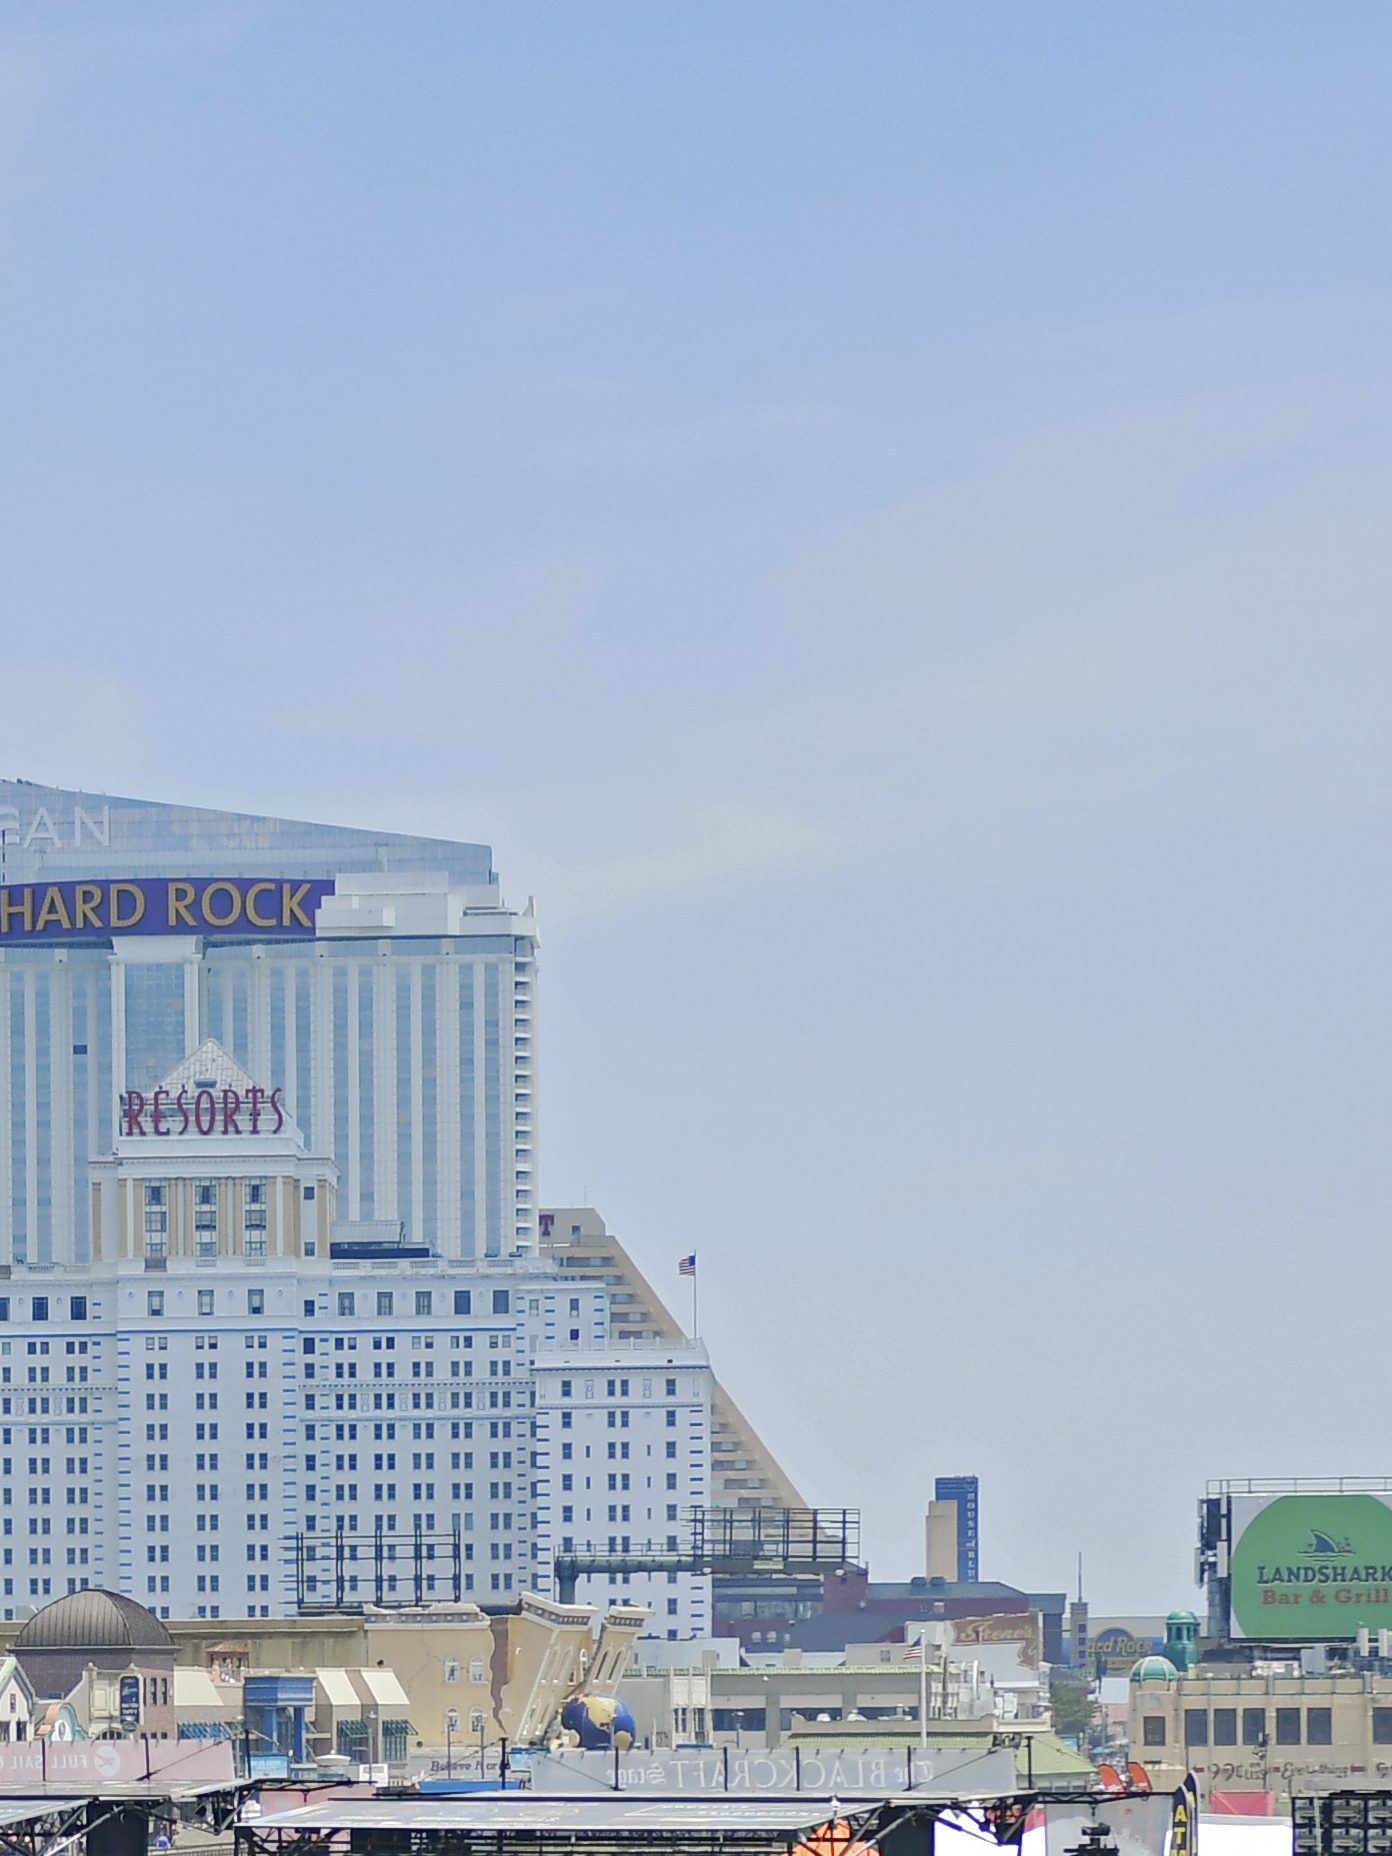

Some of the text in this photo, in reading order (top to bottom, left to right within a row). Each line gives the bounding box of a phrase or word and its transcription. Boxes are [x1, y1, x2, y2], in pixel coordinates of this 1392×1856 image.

[0, 882, 314, 932] HARD ROCK
[125, 1087, 284, 1136] RESORTS
[966, 1493, 976, 1538] HOUSE
[967, 1551, 976, 1582] BLU
[1256, 1564, 1392, 1585] LANDSHARK
[1262, 1587, 1390, 1606] Bar & Grill
[1117, 1638, 1153, 1653] Rock
